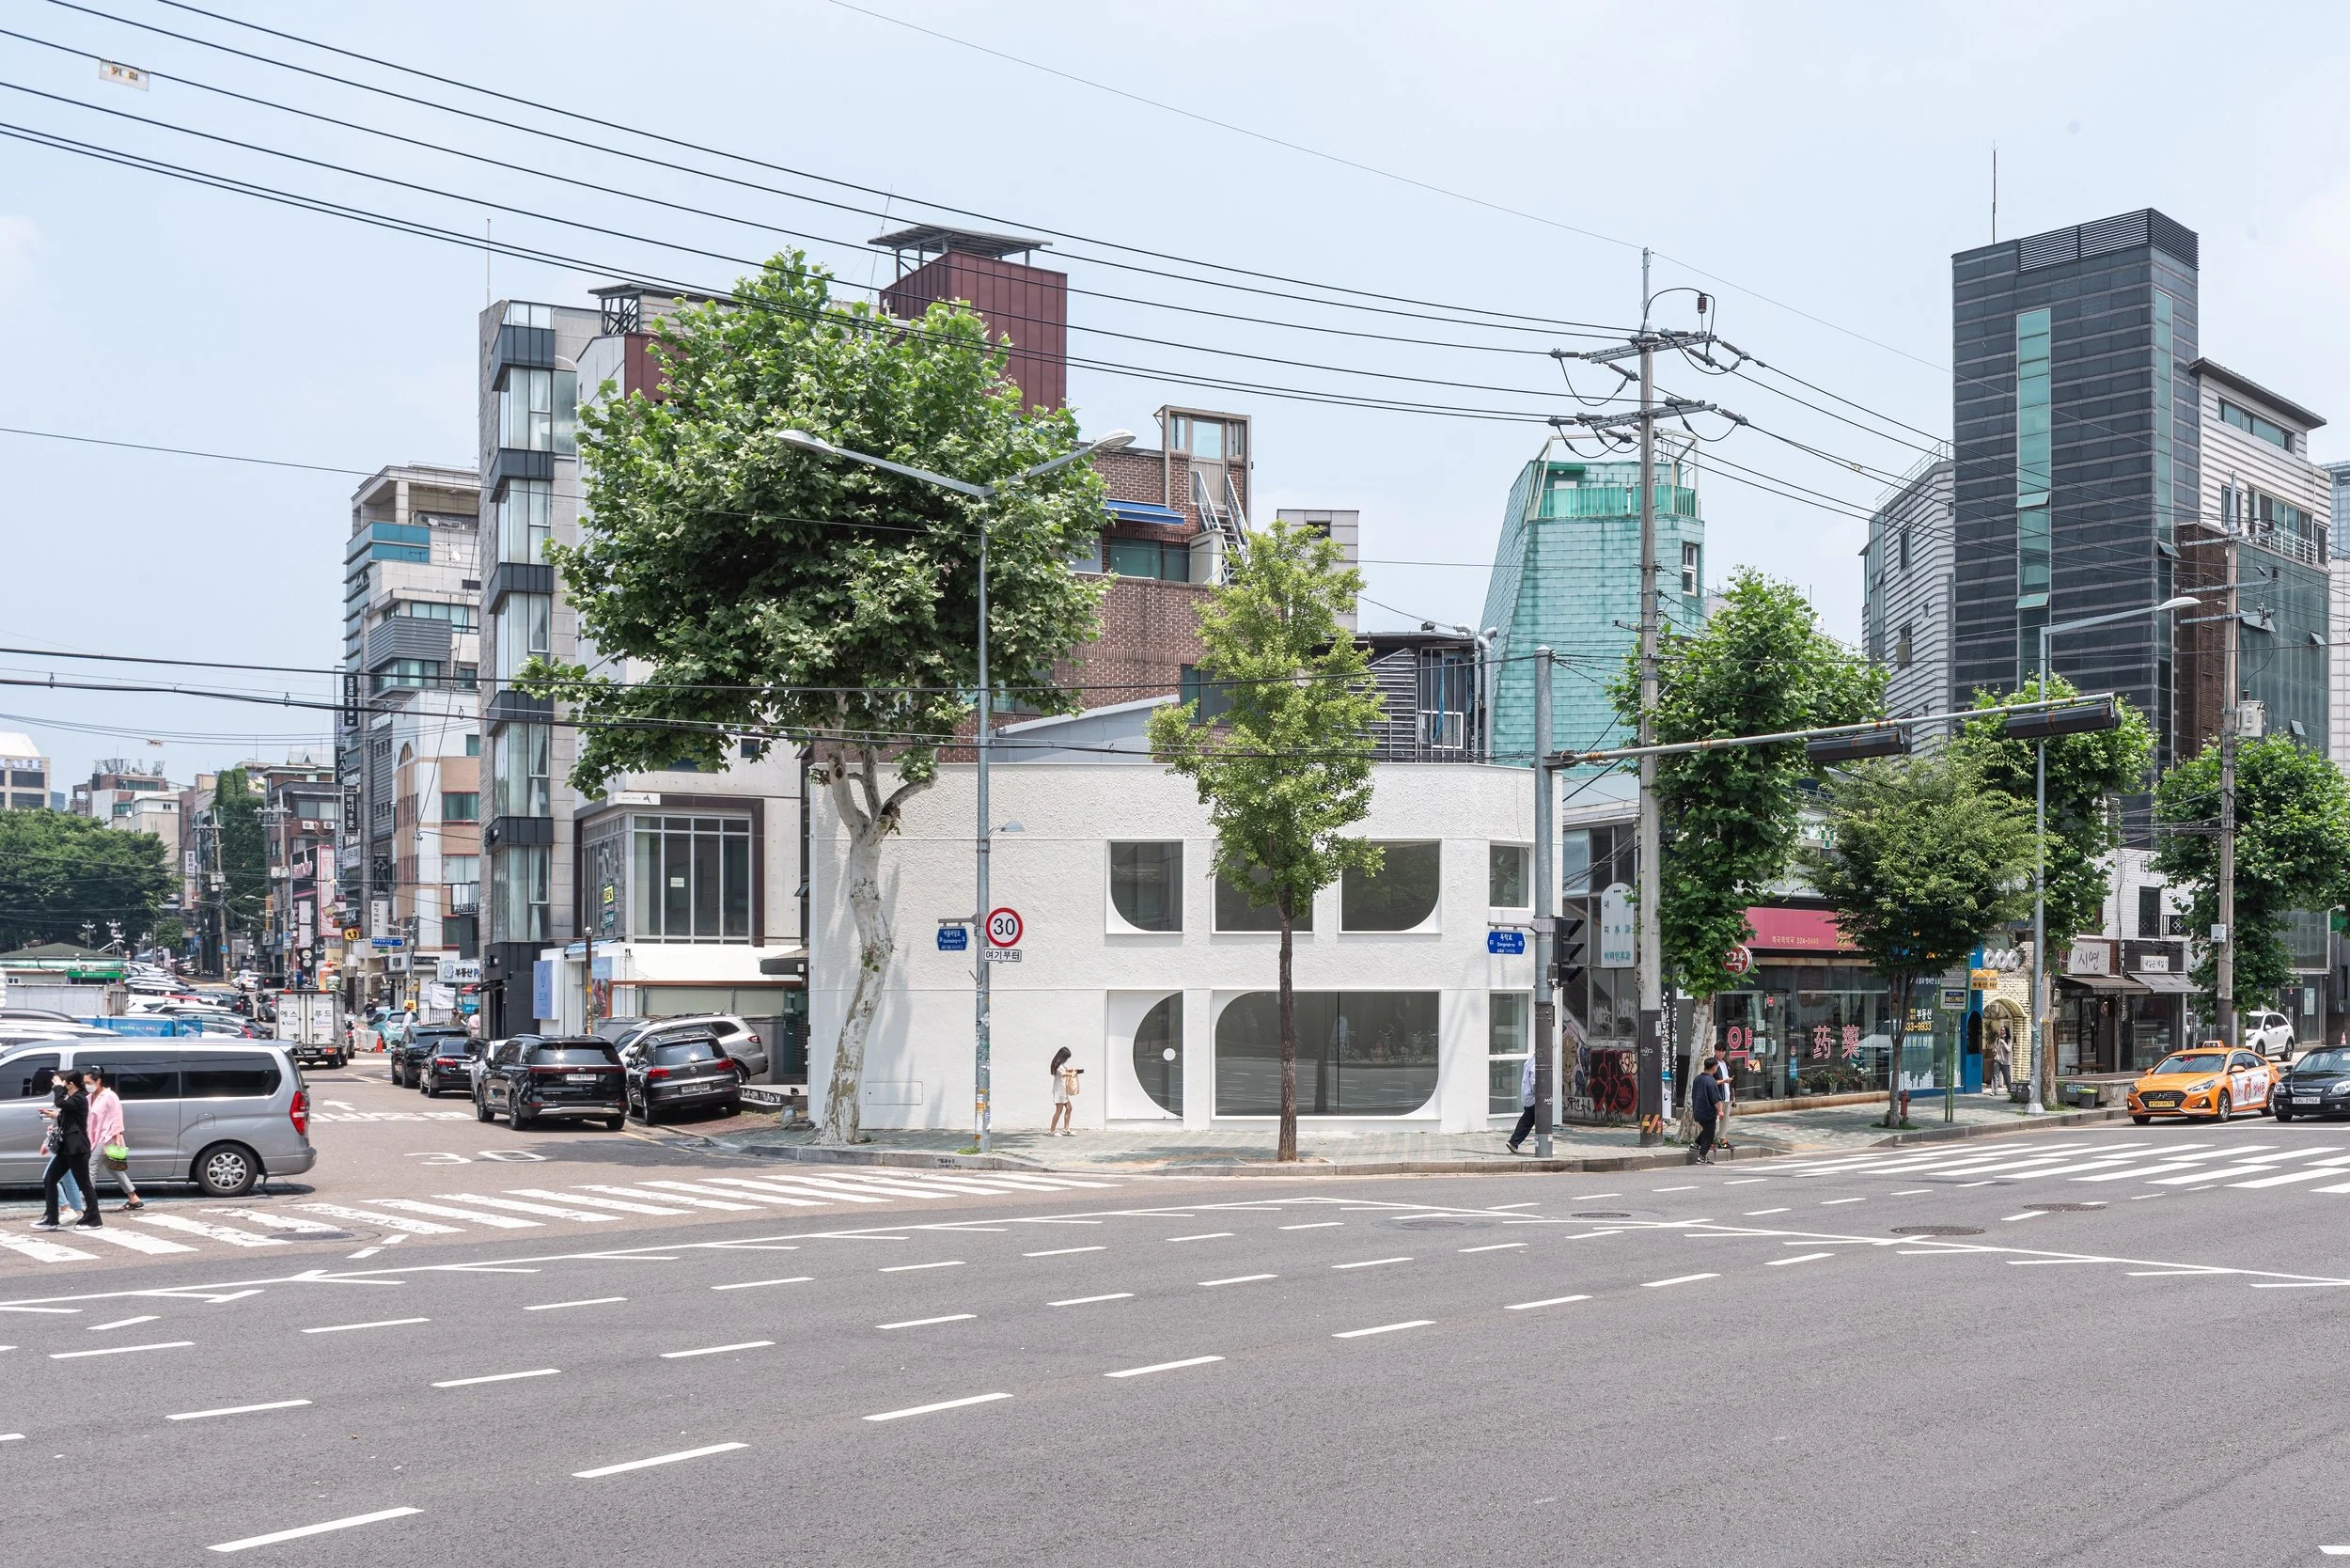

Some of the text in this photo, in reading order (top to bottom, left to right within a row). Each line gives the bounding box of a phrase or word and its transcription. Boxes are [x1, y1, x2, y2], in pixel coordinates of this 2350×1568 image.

[994, 917, 1015, 935] 30
[985, 950, 1020, 961] 여기부터
[1917, 1009, 1932, 1020] 부동산
[1728, 1026, 1752, 1068] 약
[403, 1150, 547, 1166] 30
